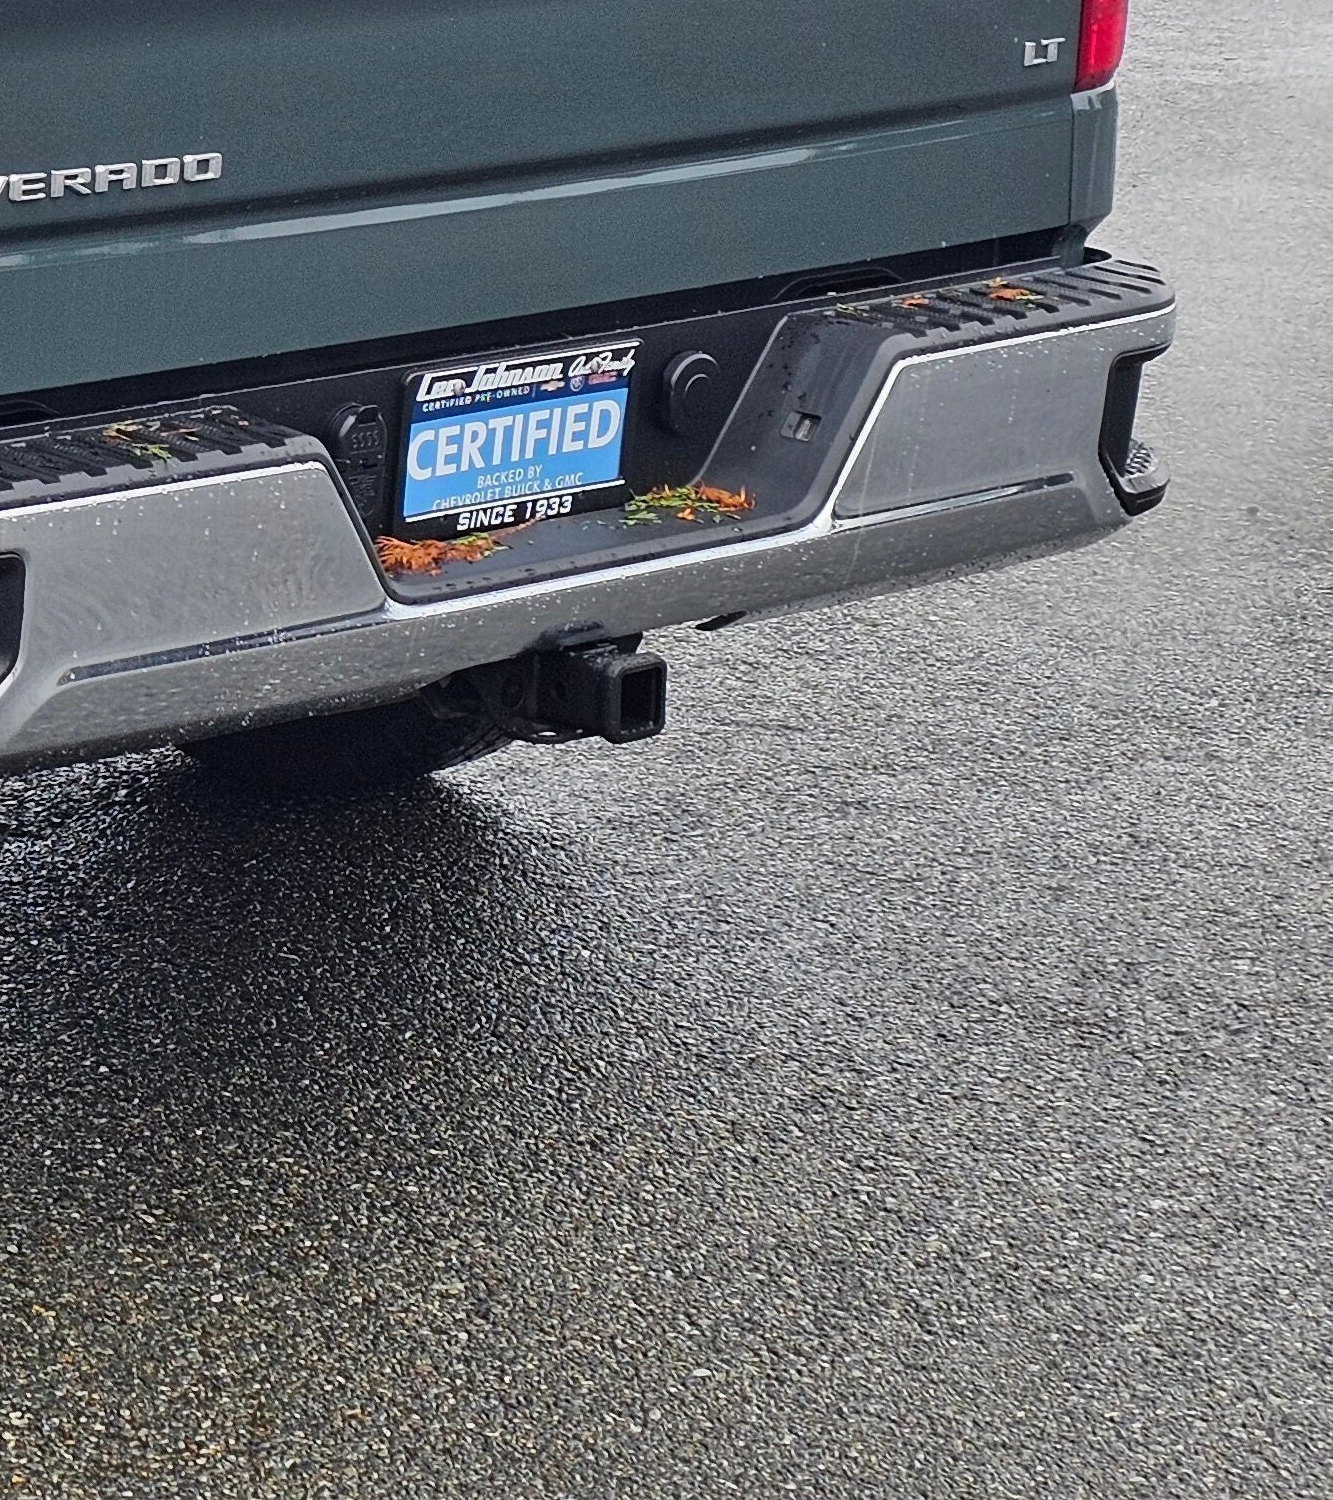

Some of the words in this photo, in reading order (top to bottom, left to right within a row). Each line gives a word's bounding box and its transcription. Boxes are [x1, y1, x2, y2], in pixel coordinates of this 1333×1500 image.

[1024, 37, 1066, 67] LT
[464, 360, 564, 393] Johnson
[422, 395, 472, 412] CERTIFIED
[407, 400, 621, 481] CERTIFIED
[433, 487, 501, 510] CHEVROLET
[504, 482, 540, 499] BUICK
[543, 479, 553, 493] &
[555, 472, 584, 488] GMC
[477, 470, 524, 489] BACKED
[527, 465, 543, 481] BY
[457, 504, 518, 531] SINCE
[525, 496, 573, 519] 1933
